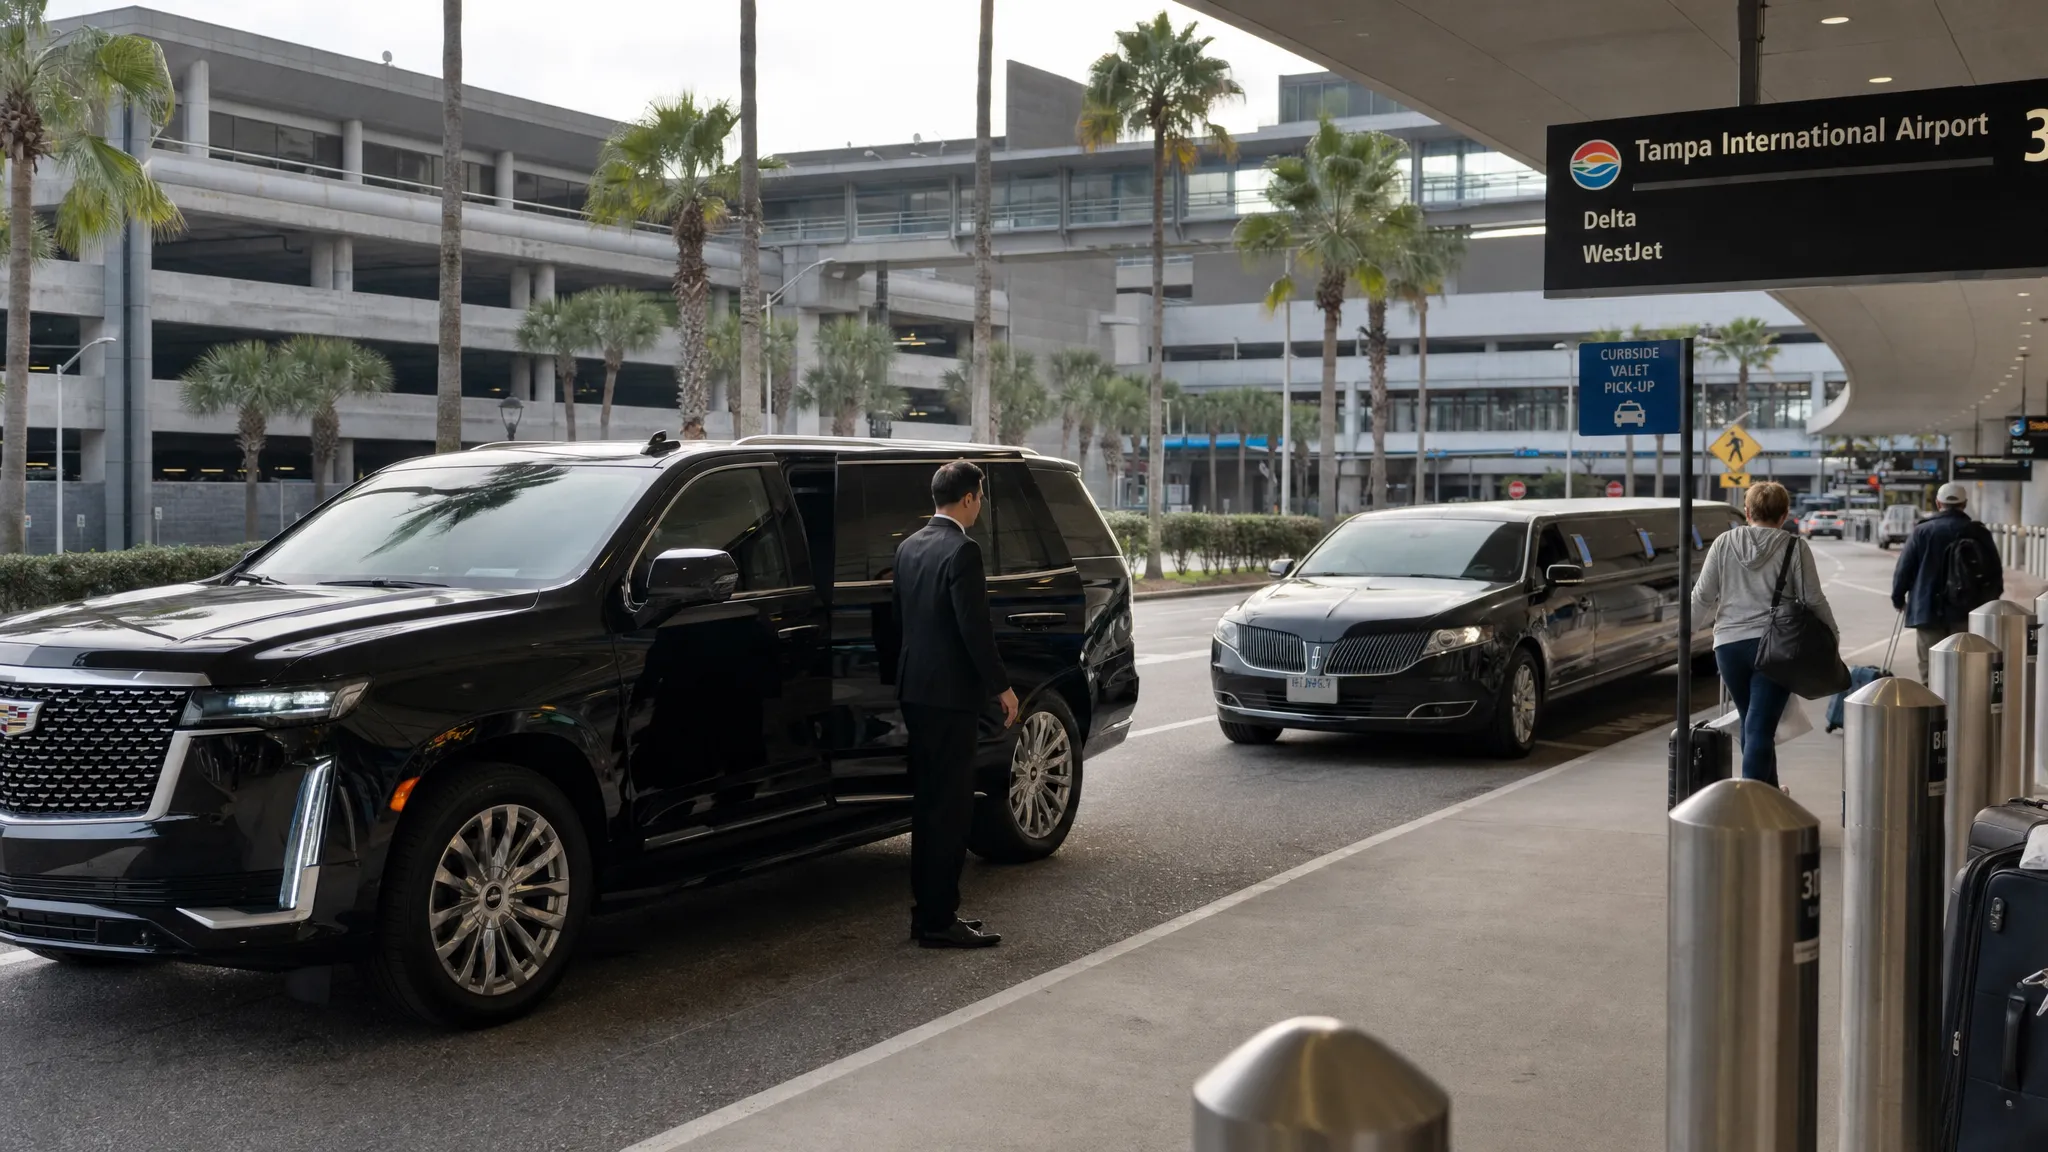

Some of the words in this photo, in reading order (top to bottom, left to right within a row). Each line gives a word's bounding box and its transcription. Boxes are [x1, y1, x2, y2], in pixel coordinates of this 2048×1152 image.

[1635, 138, 1712, 165] Tampa
[1722, 117, 1885, 155] International
[1895, 112, 1989, 146] Airport
[1584, 208, 1637, 230] Delta
[1582, 241, 1663, 264] WestJet
[1600, 347, 1660, 361] CURBSIDE
[1610, 363, 1650, 377] VALET
[1604, 380, 1655, 394] PICK-UP
